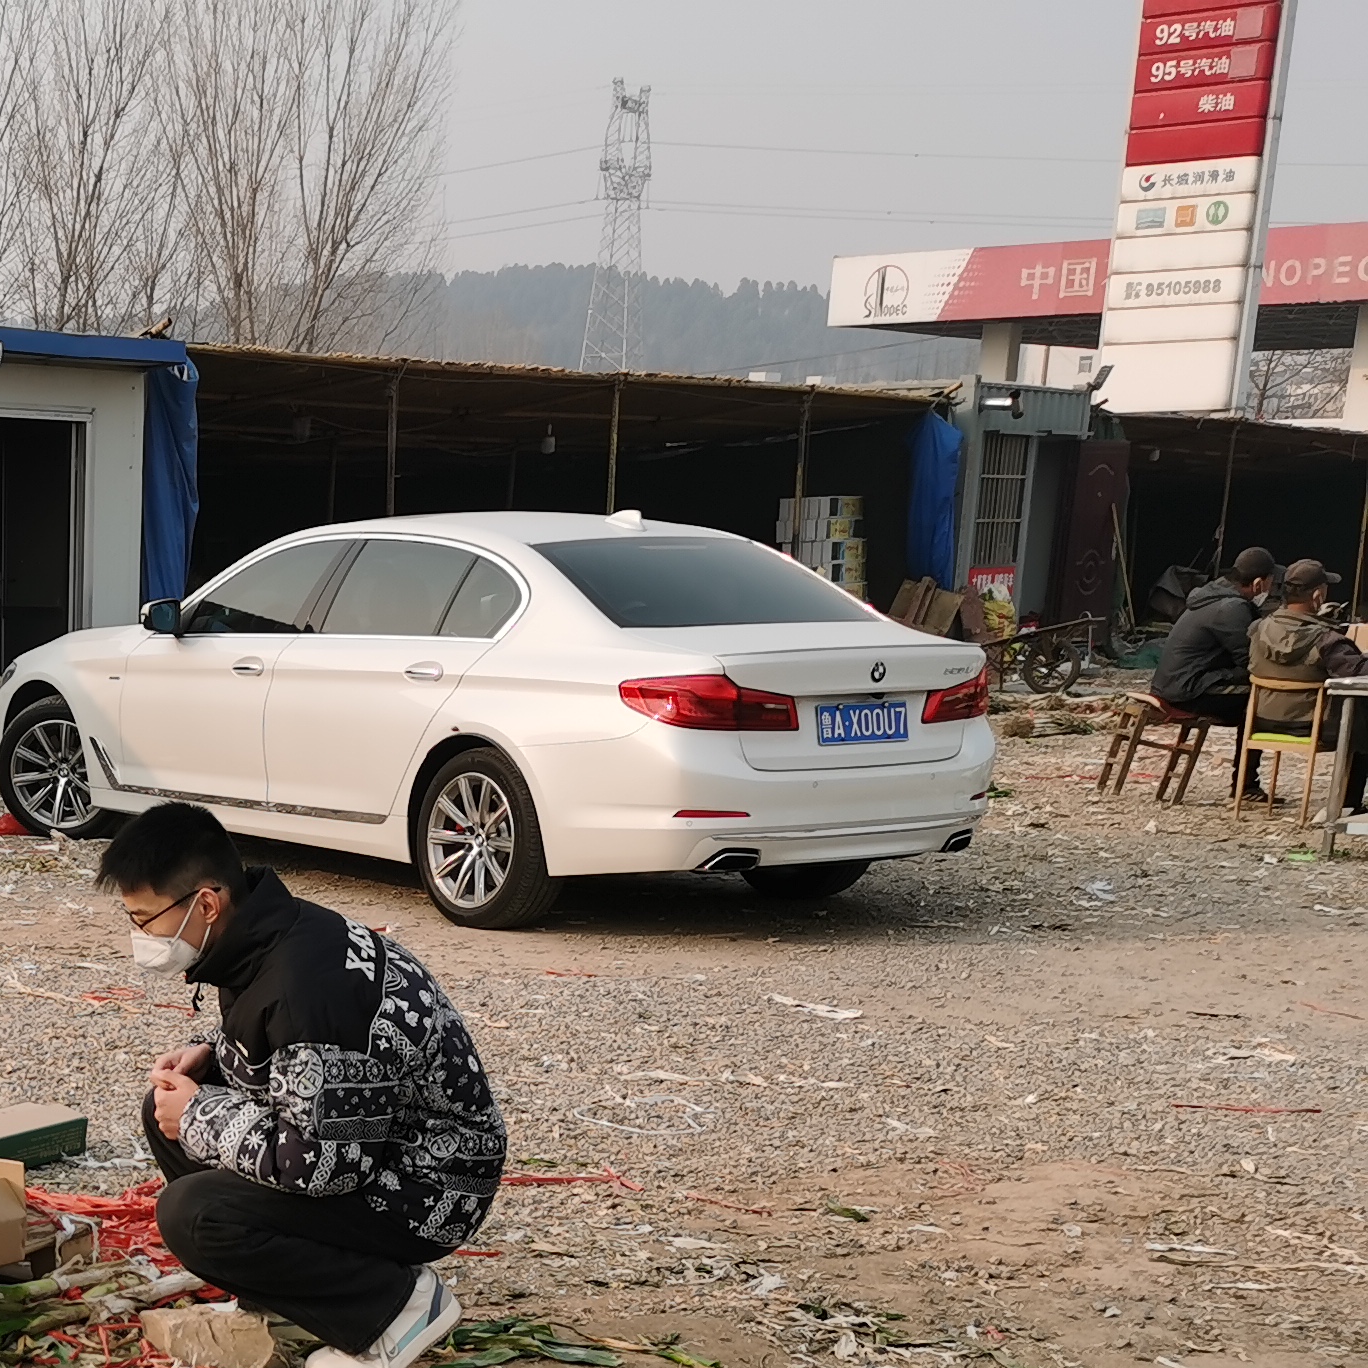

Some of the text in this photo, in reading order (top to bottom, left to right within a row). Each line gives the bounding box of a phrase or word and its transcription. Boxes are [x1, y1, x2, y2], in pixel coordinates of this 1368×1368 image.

[1155, 17, 1235, 46] 92号汽油
[1150, 55, 1230, 83] 95号汽油
[1197, 92, 1234, 113] 柴油
[1161, 168, 1236, 188] 长城润滑油
[1020, 257, 1109, 300] 中国
